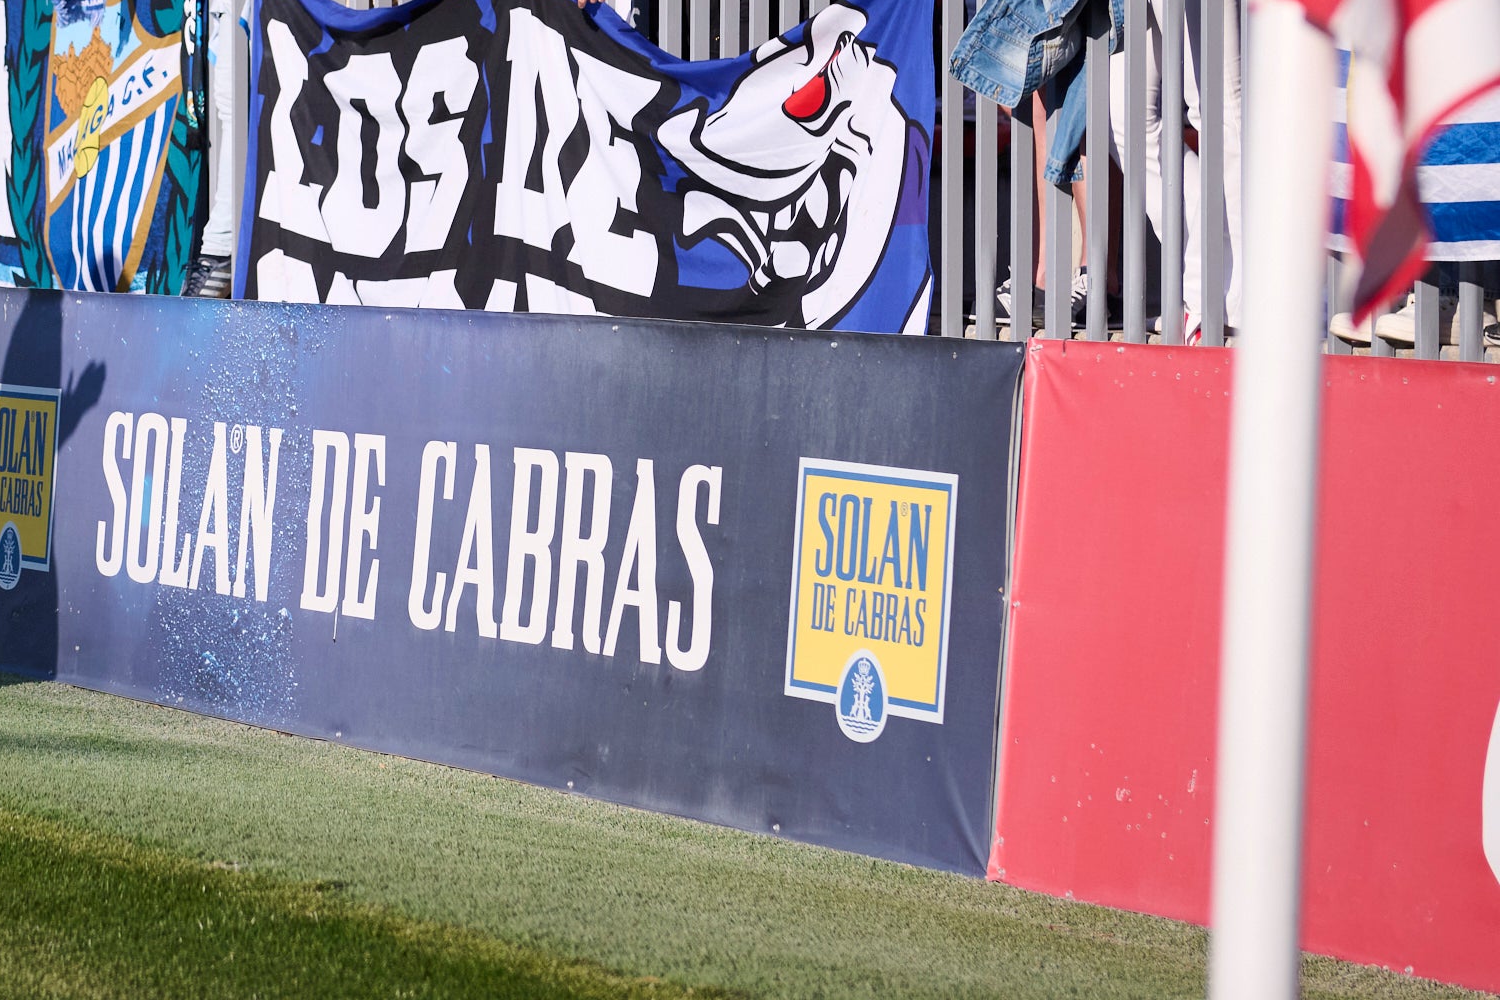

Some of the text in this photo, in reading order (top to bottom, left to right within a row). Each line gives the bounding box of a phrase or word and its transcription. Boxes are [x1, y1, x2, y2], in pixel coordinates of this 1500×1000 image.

[259, 6, 663, 299] LOS DE
[0, 476, 44, 518] CABRAS
[300, 430, 386, 620] DE
[408, 440, 723, 672] CABRAS
[811, 582, 927, 648] DE CABRAS
